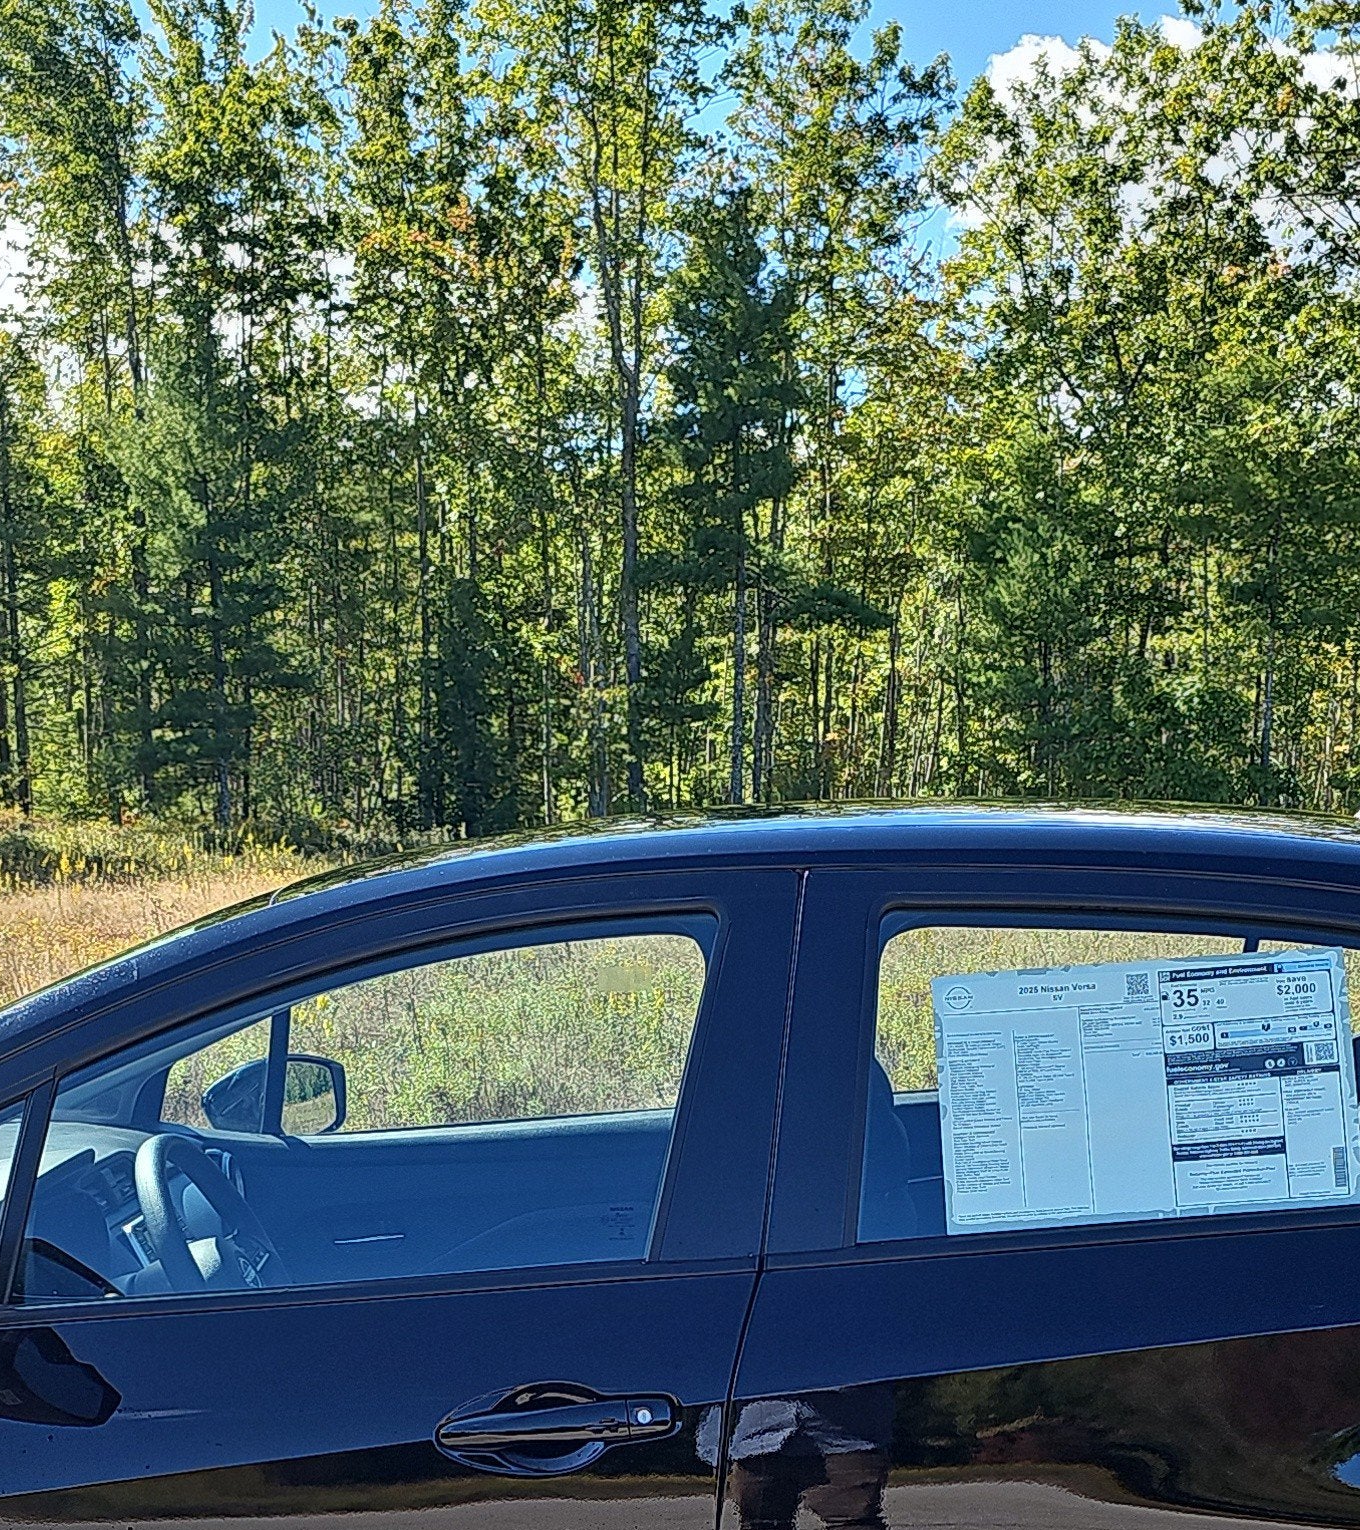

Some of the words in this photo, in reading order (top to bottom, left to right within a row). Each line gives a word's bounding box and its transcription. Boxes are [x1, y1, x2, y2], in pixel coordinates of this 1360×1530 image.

[1040, 984, 1070, 993] Nissan
[1277, 983, 1316, 995] $2,000
[1172, 988, 1199, 1008] 35
[1169, 1033, 1210, 1046] $1,500
